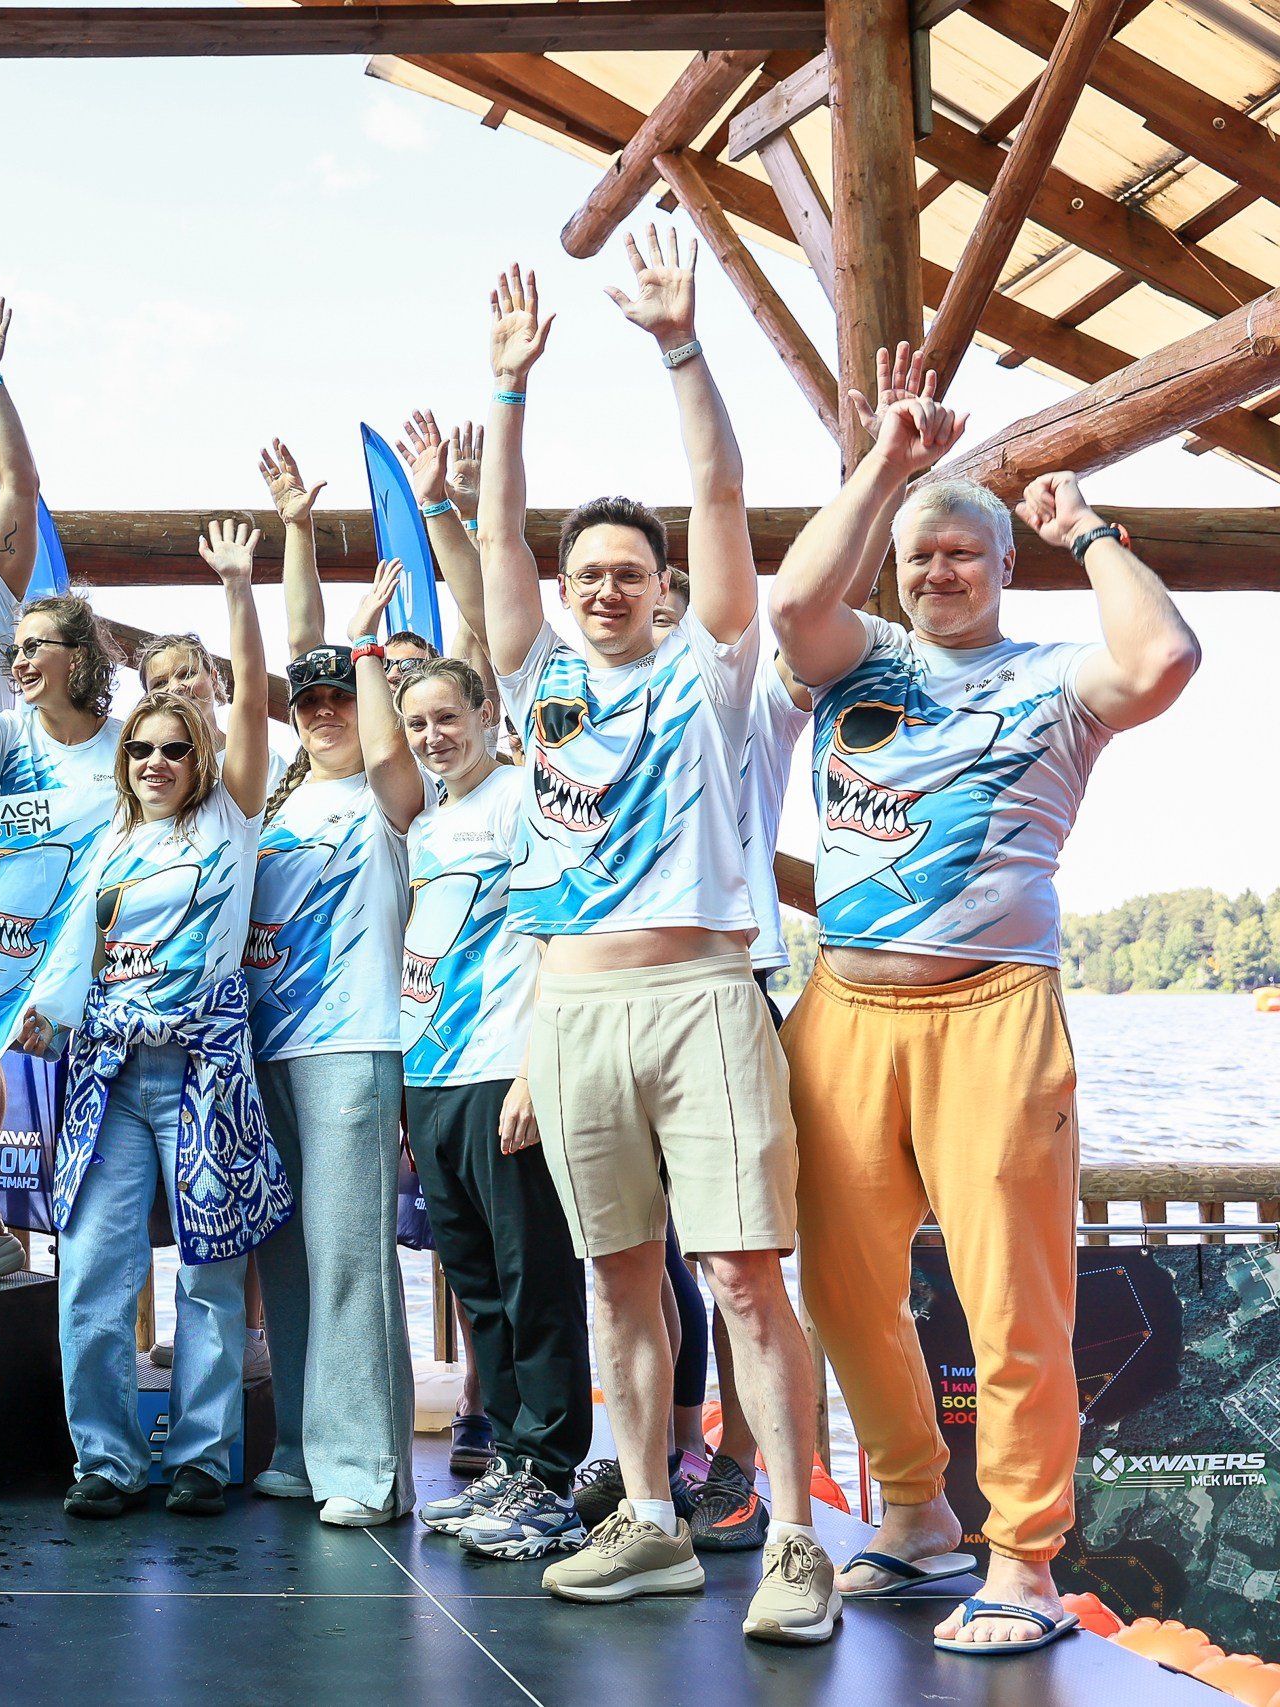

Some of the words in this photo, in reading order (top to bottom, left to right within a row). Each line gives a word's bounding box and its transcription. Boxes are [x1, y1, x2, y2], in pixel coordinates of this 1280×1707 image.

[940, 1364, 949, 1377] 1
[940, 1380, 949, 1393] 1
[941, 1395, 977, 1409] 500
[1191, 1474, 1220, 1487] МСК
[1223, 1473, 1267, 1486] ИСТРА
